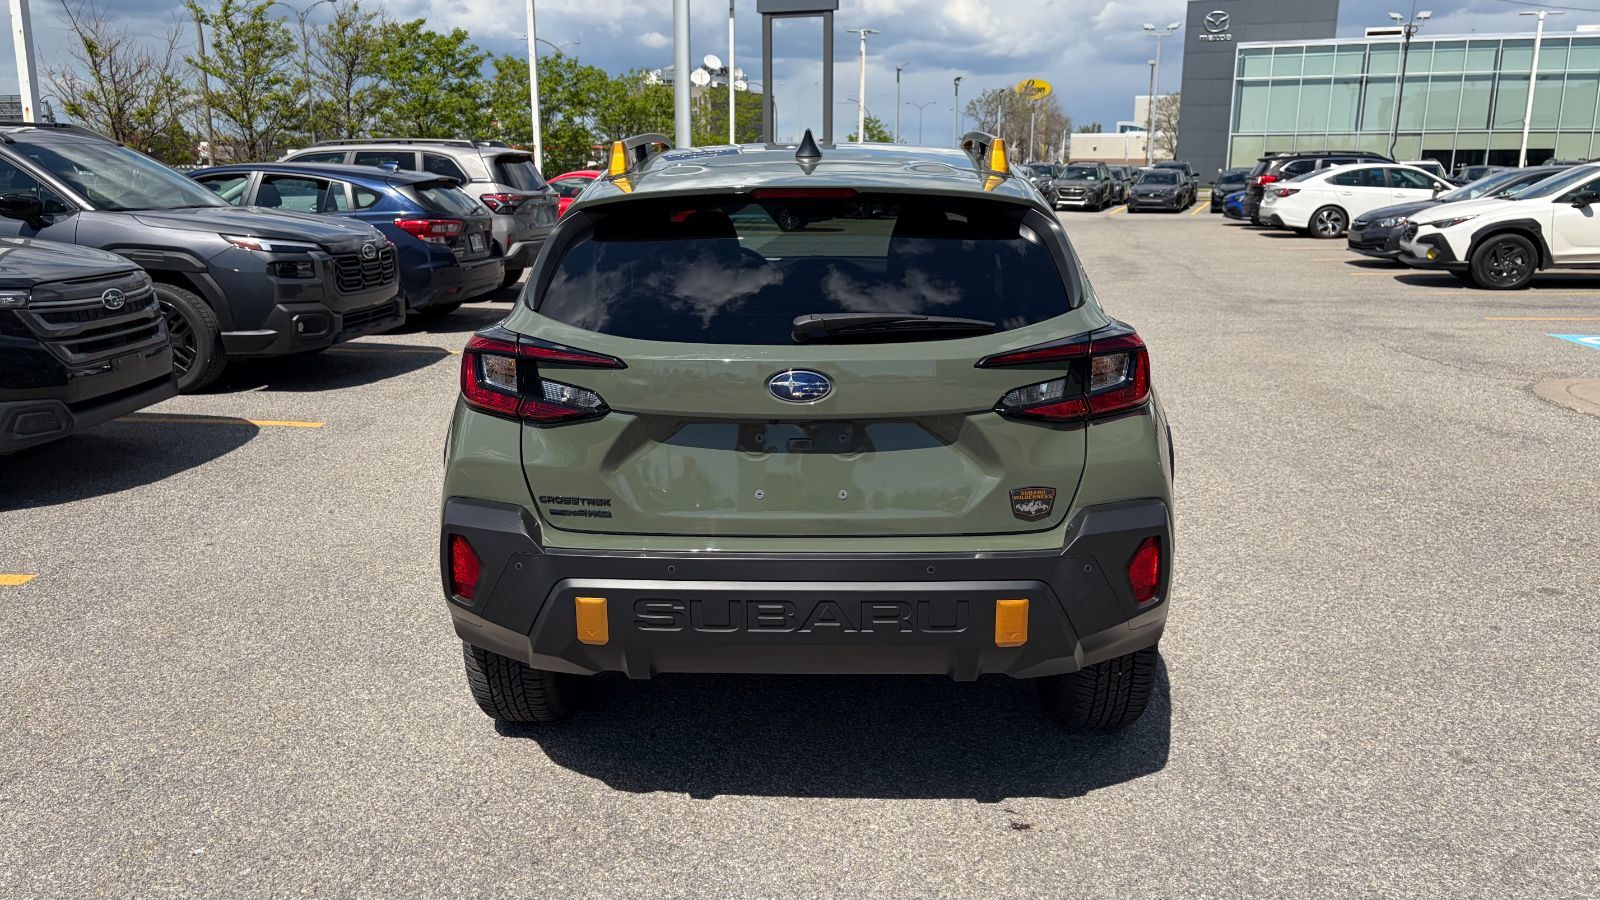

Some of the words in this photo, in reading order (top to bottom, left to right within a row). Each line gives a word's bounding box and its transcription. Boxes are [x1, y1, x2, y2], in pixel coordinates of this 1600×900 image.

[1199, 33, 1232, 41] mazda
[539, 495, 612, 507] CROSSTREK
[633, 597, 970, 634] SUBARU
